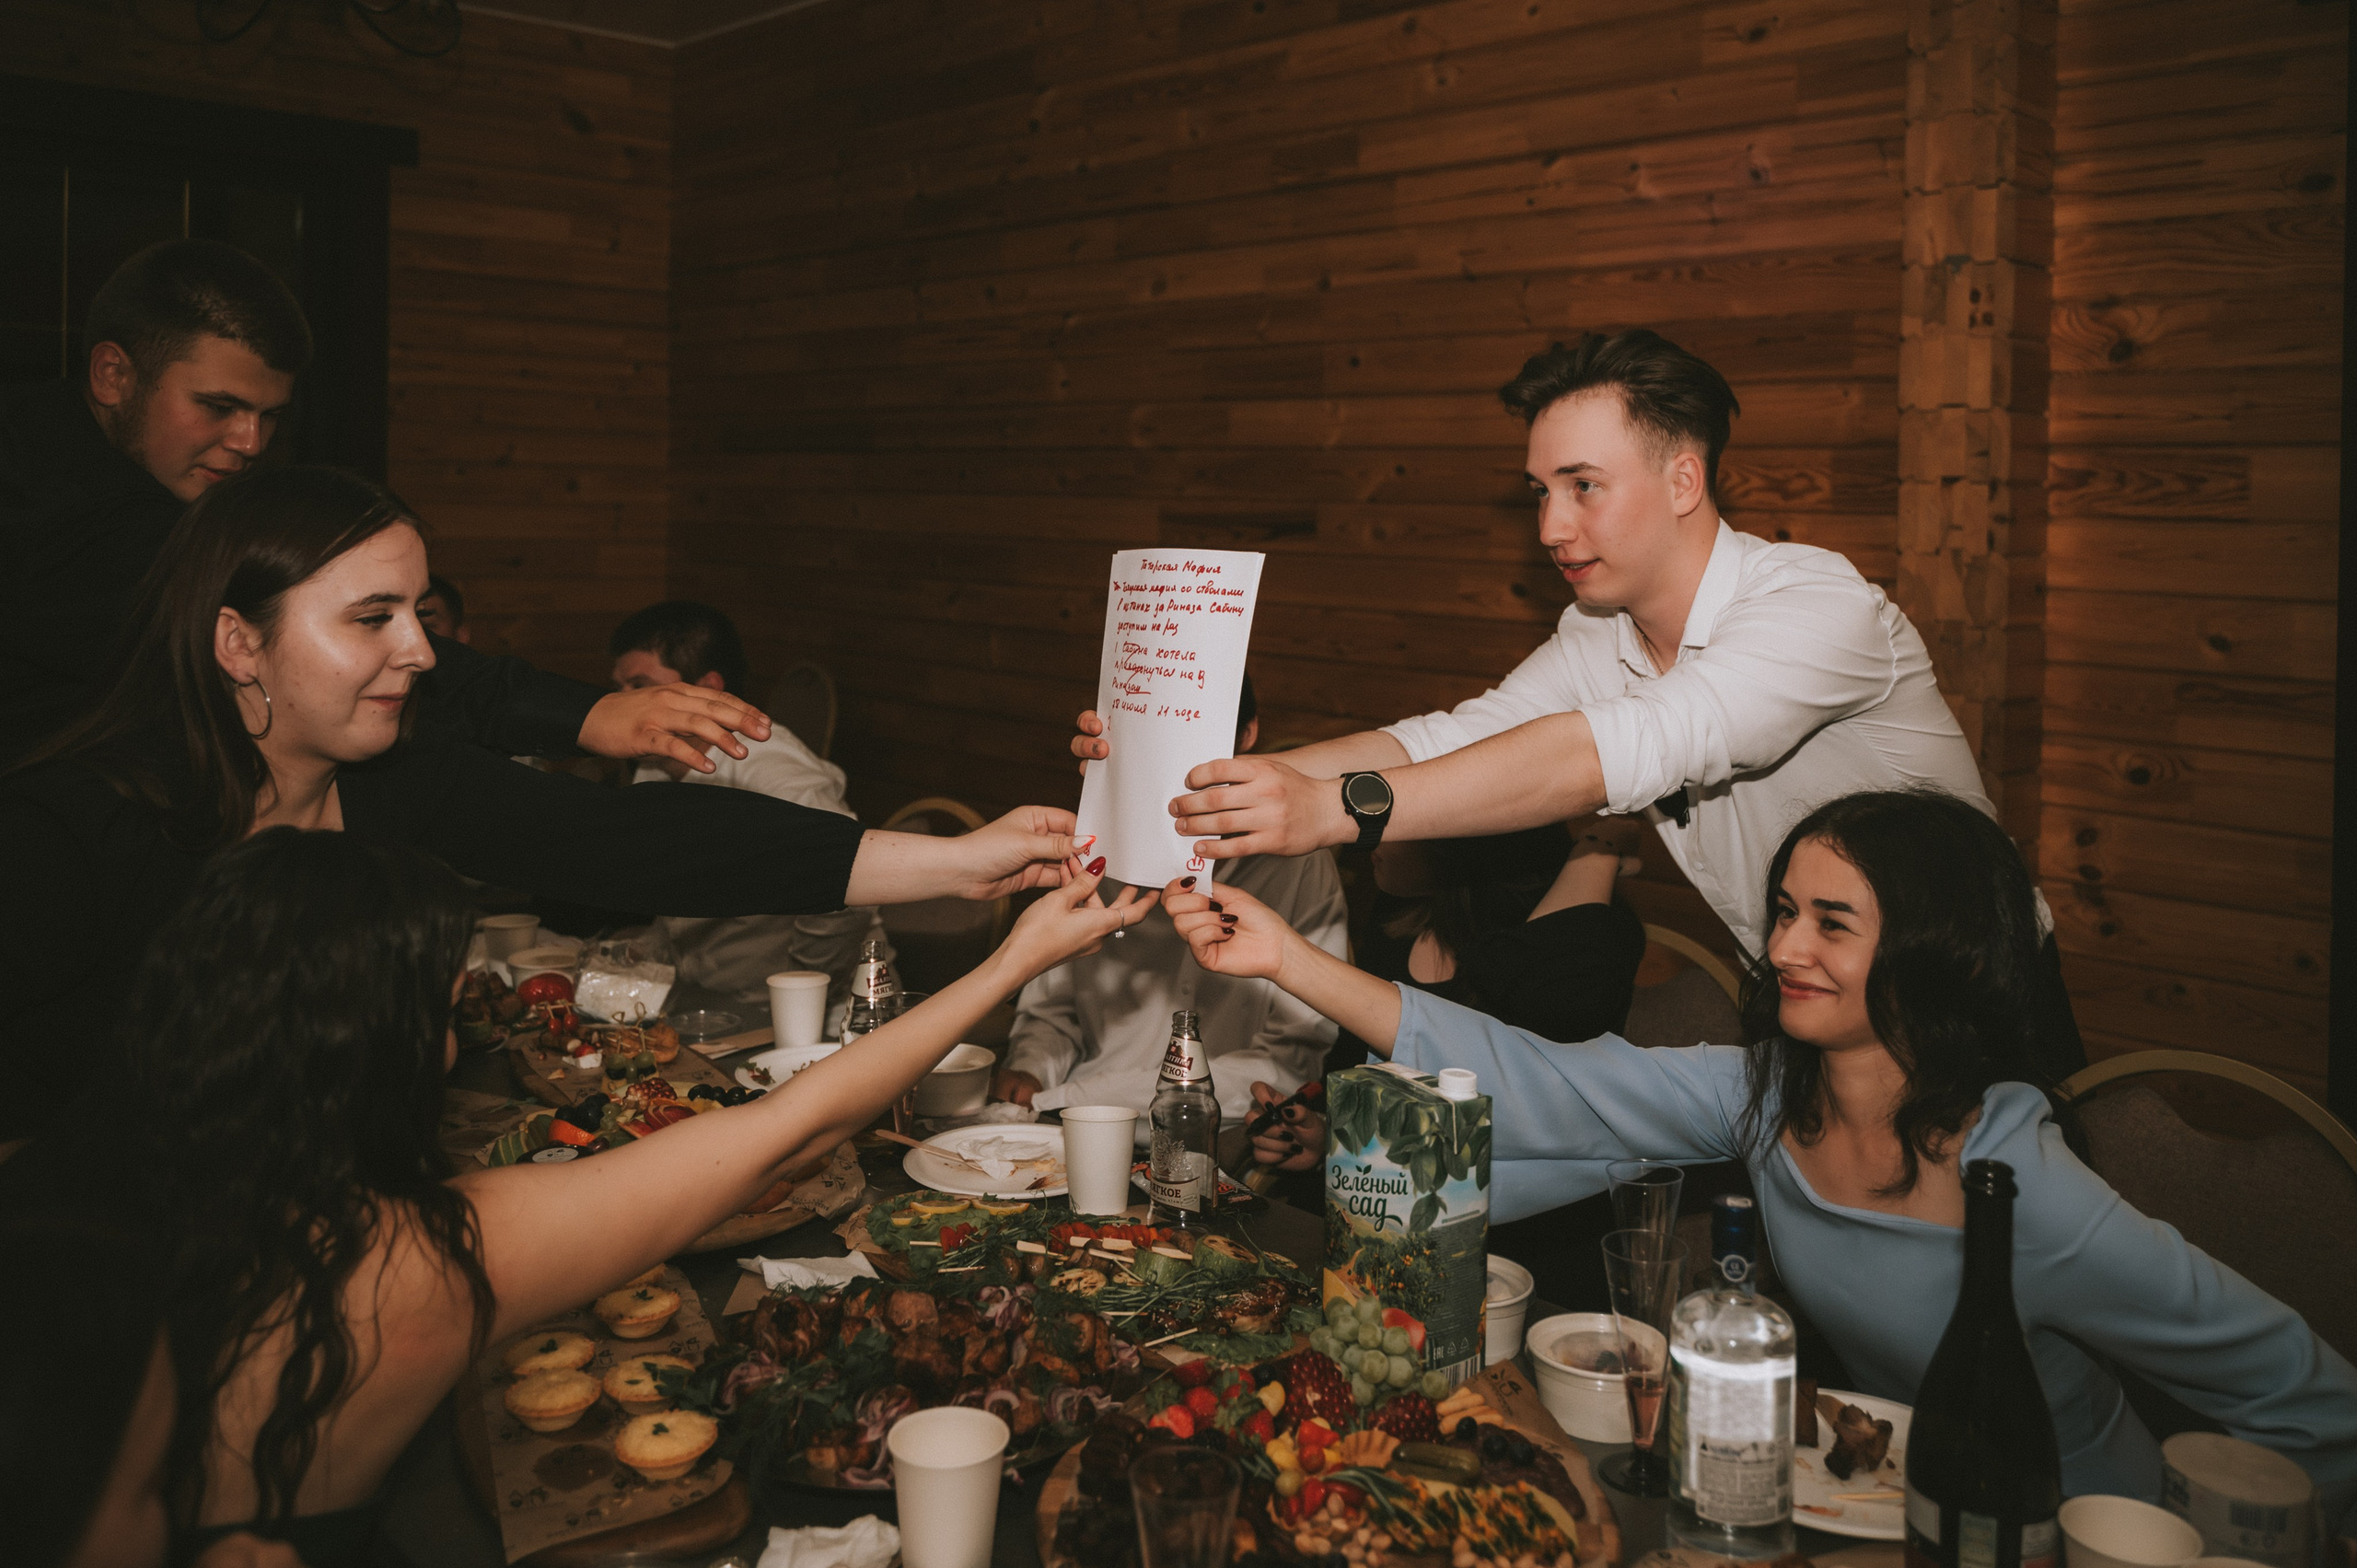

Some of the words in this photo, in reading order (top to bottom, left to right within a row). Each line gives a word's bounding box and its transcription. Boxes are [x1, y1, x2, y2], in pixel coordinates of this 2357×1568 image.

[1180, 586, 1192, 594] со
[1195, 579, 1245, 598] стволами
[1151, 621, 1162, 633] на
[1155, 647, 1197, 661] хотела
[1331, 1164, 1408, 1195] Зелёный
[1151, 1181, 1181, 1199] ЯГКОЕ
[1349, 1195, 1403, 1232] сад
